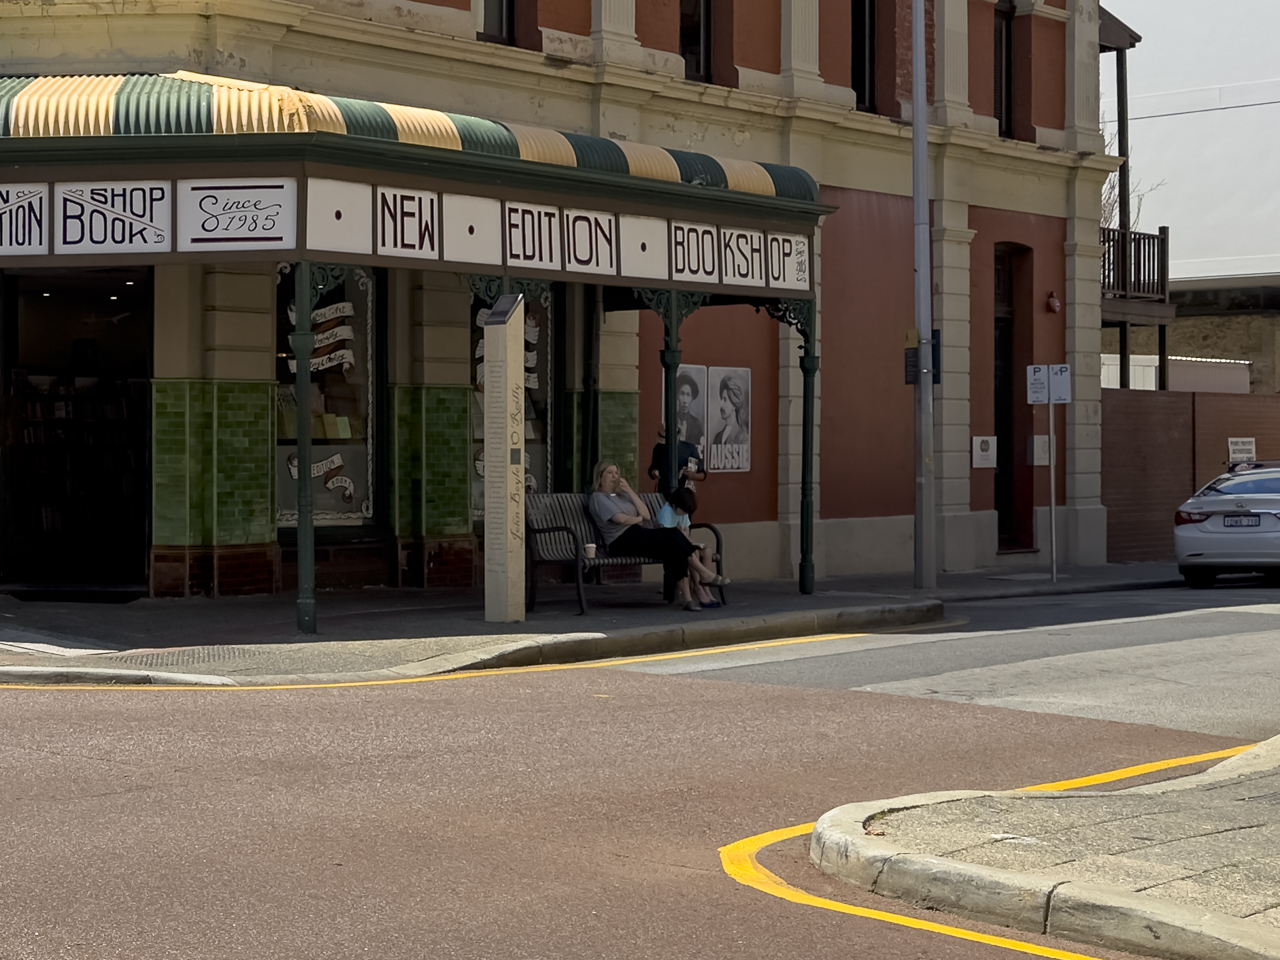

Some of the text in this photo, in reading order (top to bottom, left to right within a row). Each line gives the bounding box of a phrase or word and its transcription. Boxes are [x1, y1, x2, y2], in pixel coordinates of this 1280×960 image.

[62, 196, 148, 245] BOOK
[90, 187, 165, 223] SHOP
[198, 194, 282, 233] Since
[221, 211, 280, 232] 1985
[380, 192, 793, 283] NEW EDITION BOOKSHOP
[1033, 366, 1041, 376] P
[710, 443, 749, 469] AUSSIE
